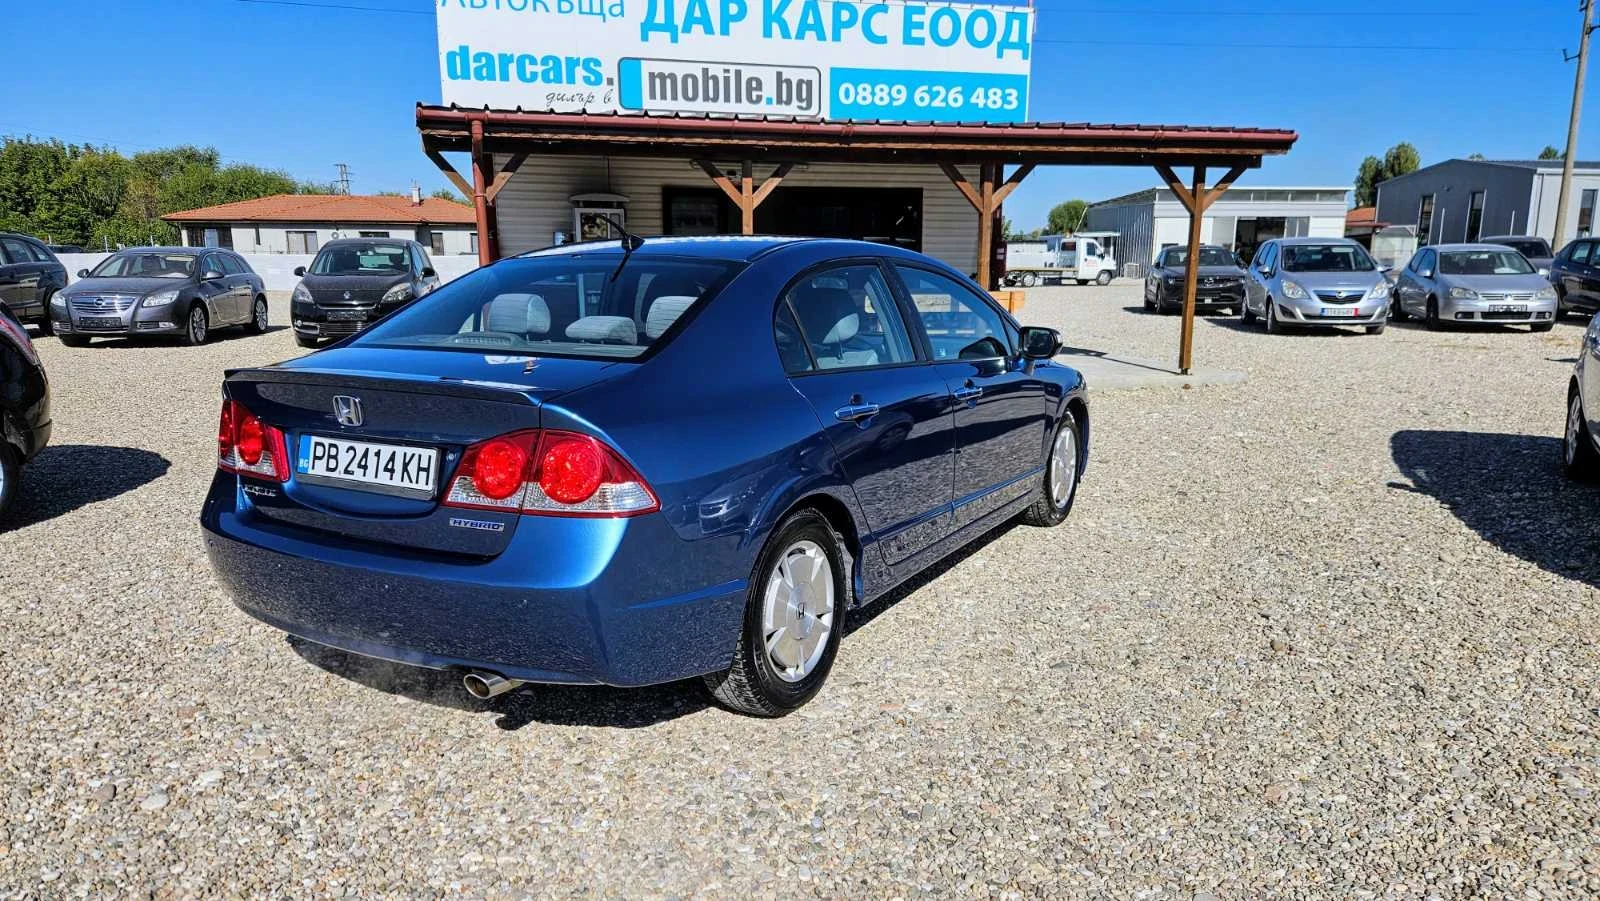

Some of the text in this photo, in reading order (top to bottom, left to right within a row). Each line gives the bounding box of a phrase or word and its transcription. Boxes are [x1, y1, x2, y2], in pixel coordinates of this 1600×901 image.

[440, 0, 625, 23] окъща
[640, 0, 1031, 60] ДАР КАРС ЕООД
[648, 67, 813, 111] mobile.bg
[838, 82, 1019, 110] 0889 626 483
[453, 520, 500, 530] HYBRID
